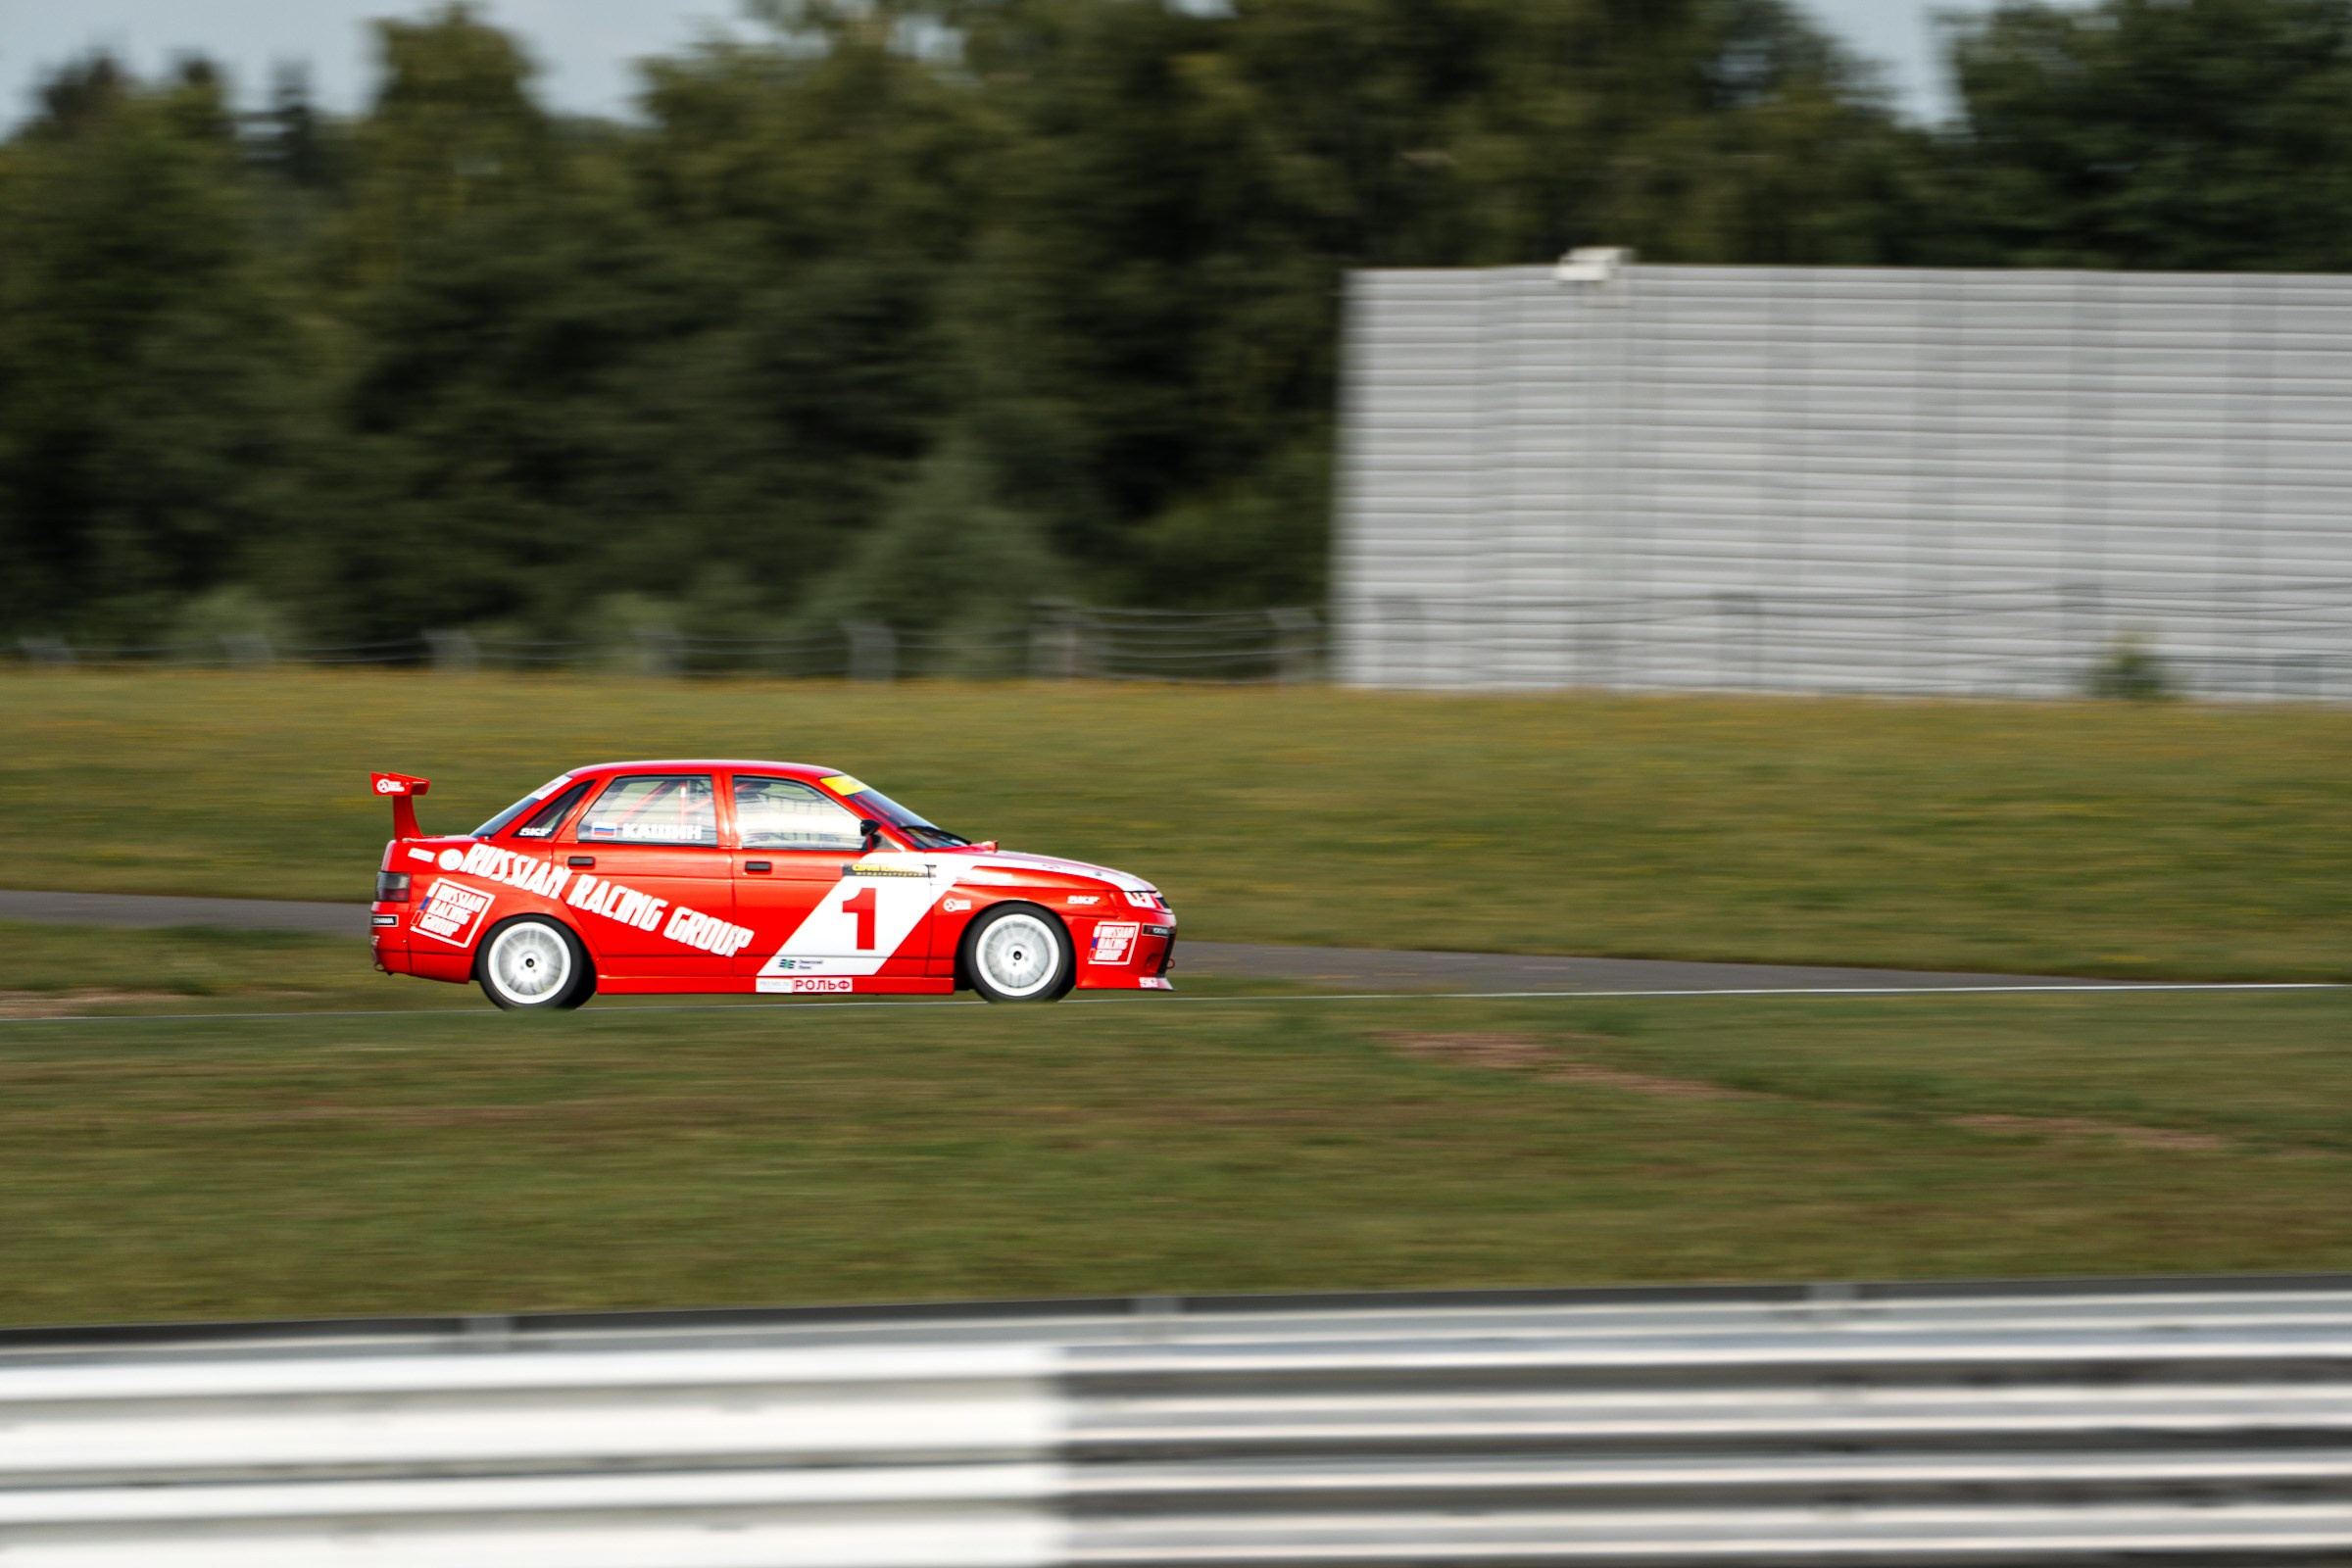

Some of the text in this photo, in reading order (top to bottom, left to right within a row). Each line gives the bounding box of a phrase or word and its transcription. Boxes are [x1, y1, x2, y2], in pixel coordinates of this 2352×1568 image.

[518, 827, 553, 837] SKF
[621, 823, 703, 840] КАШИН
[434, 884, 488, 912] RUSSIAN
[459, 843, 755, 957] RUSSIAN RACING GROUP
[426, 899, 472, 925] RACING
[842, 887, 877, 951] 1
[795, 979, 850, 991] РОЛЬФ
